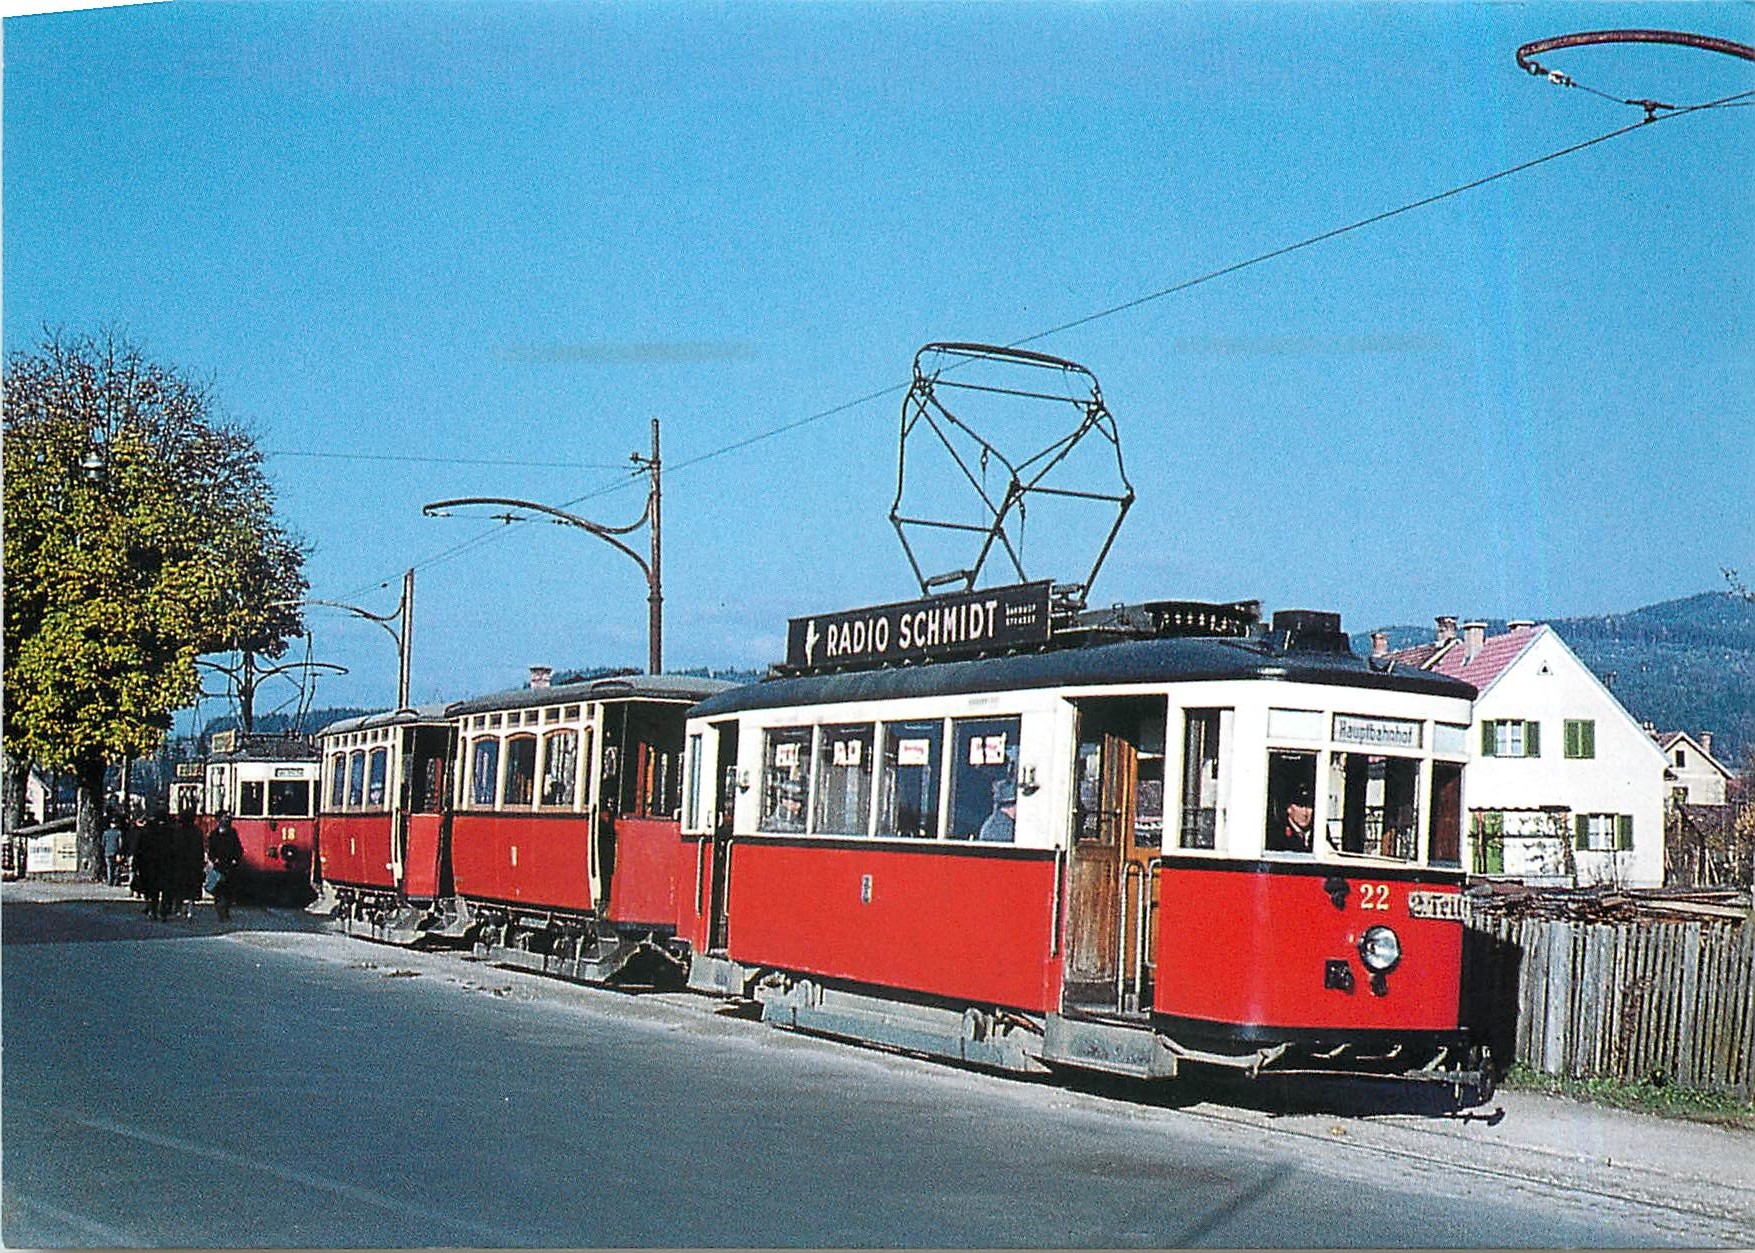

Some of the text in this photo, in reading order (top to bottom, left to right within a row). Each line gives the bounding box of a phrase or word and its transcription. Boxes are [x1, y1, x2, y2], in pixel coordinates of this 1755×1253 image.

[826, 599, 998, 658] RADIO SCHMIDT
[1338, 719, 1413, 744] Hauptbahnhof
[281, 827, 296, 841] 18
[1359, 884, 1390, 911] 22
